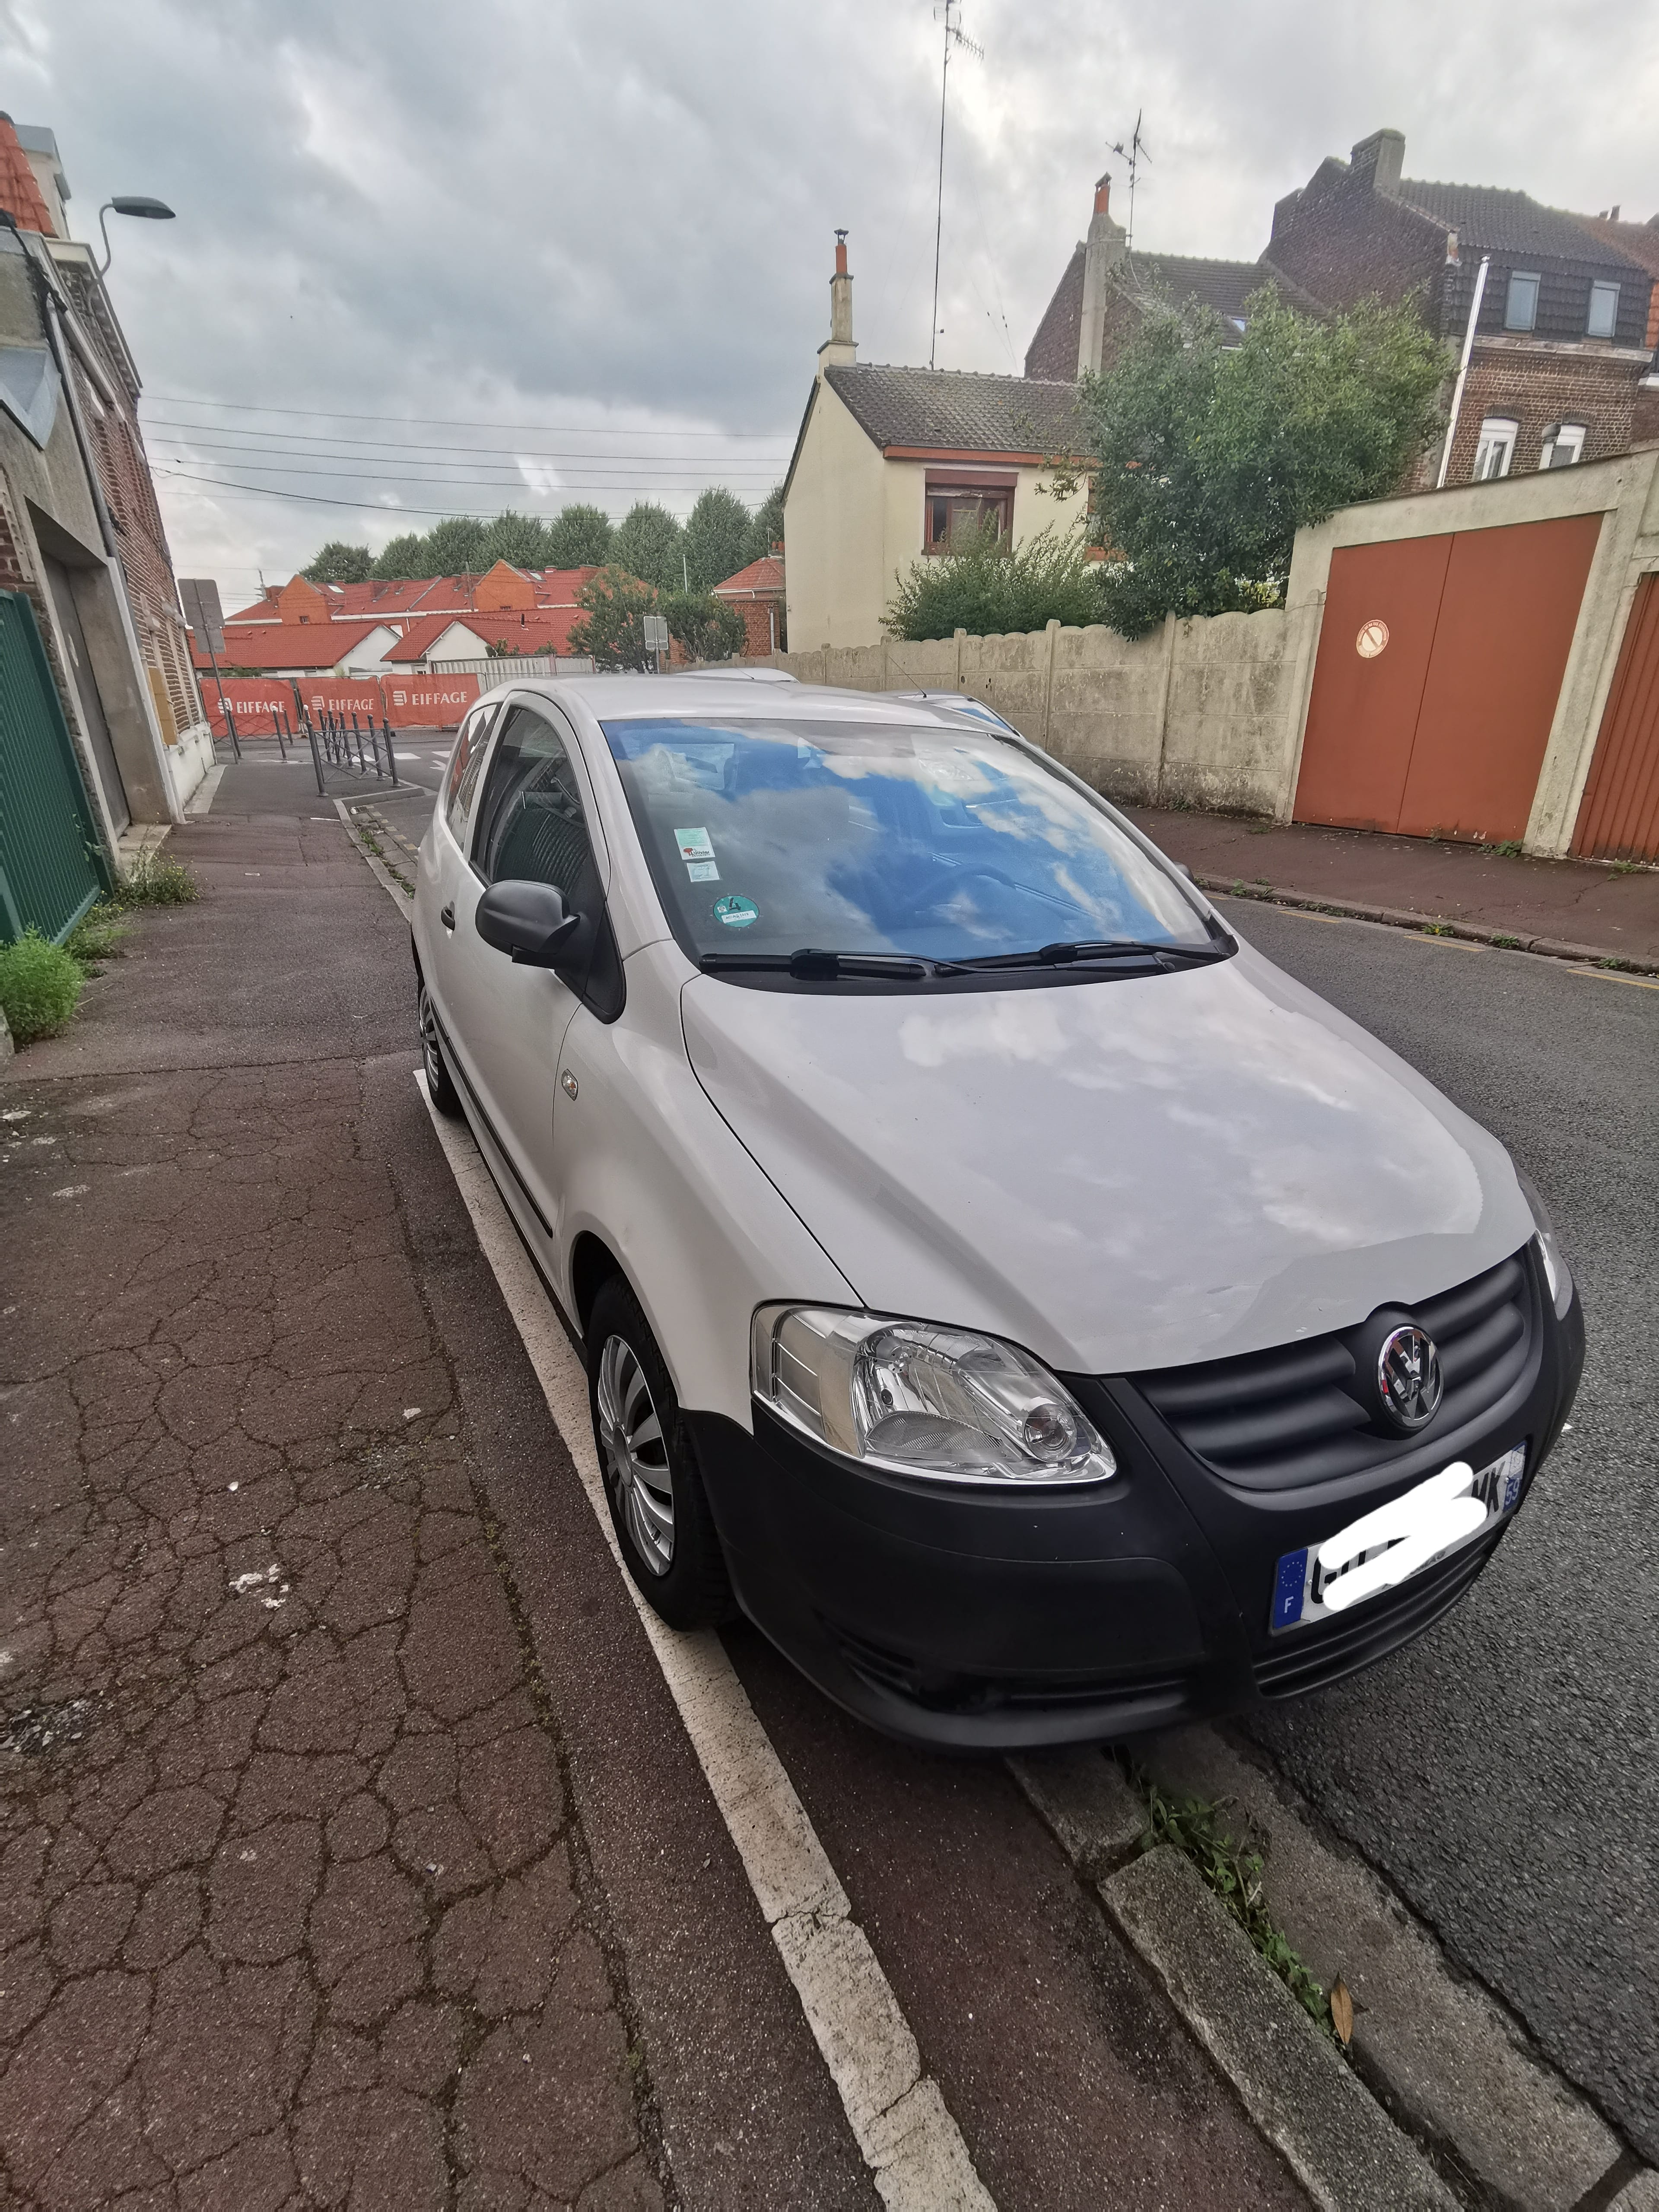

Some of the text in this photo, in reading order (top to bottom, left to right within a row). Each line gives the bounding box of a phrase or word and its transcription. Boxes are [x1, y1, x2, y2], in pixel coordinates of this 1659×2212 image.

[412, 691, 467, 705] EIFFAGE
[236, 701, 285, 713] EIFFAGE
[328, 699, 374, 711] EIFFAGE
[729, 897, 741, 910] 4
[1505, 1478, 1520, 1505] 59
[1284, 1595, 1294, 1613] F
